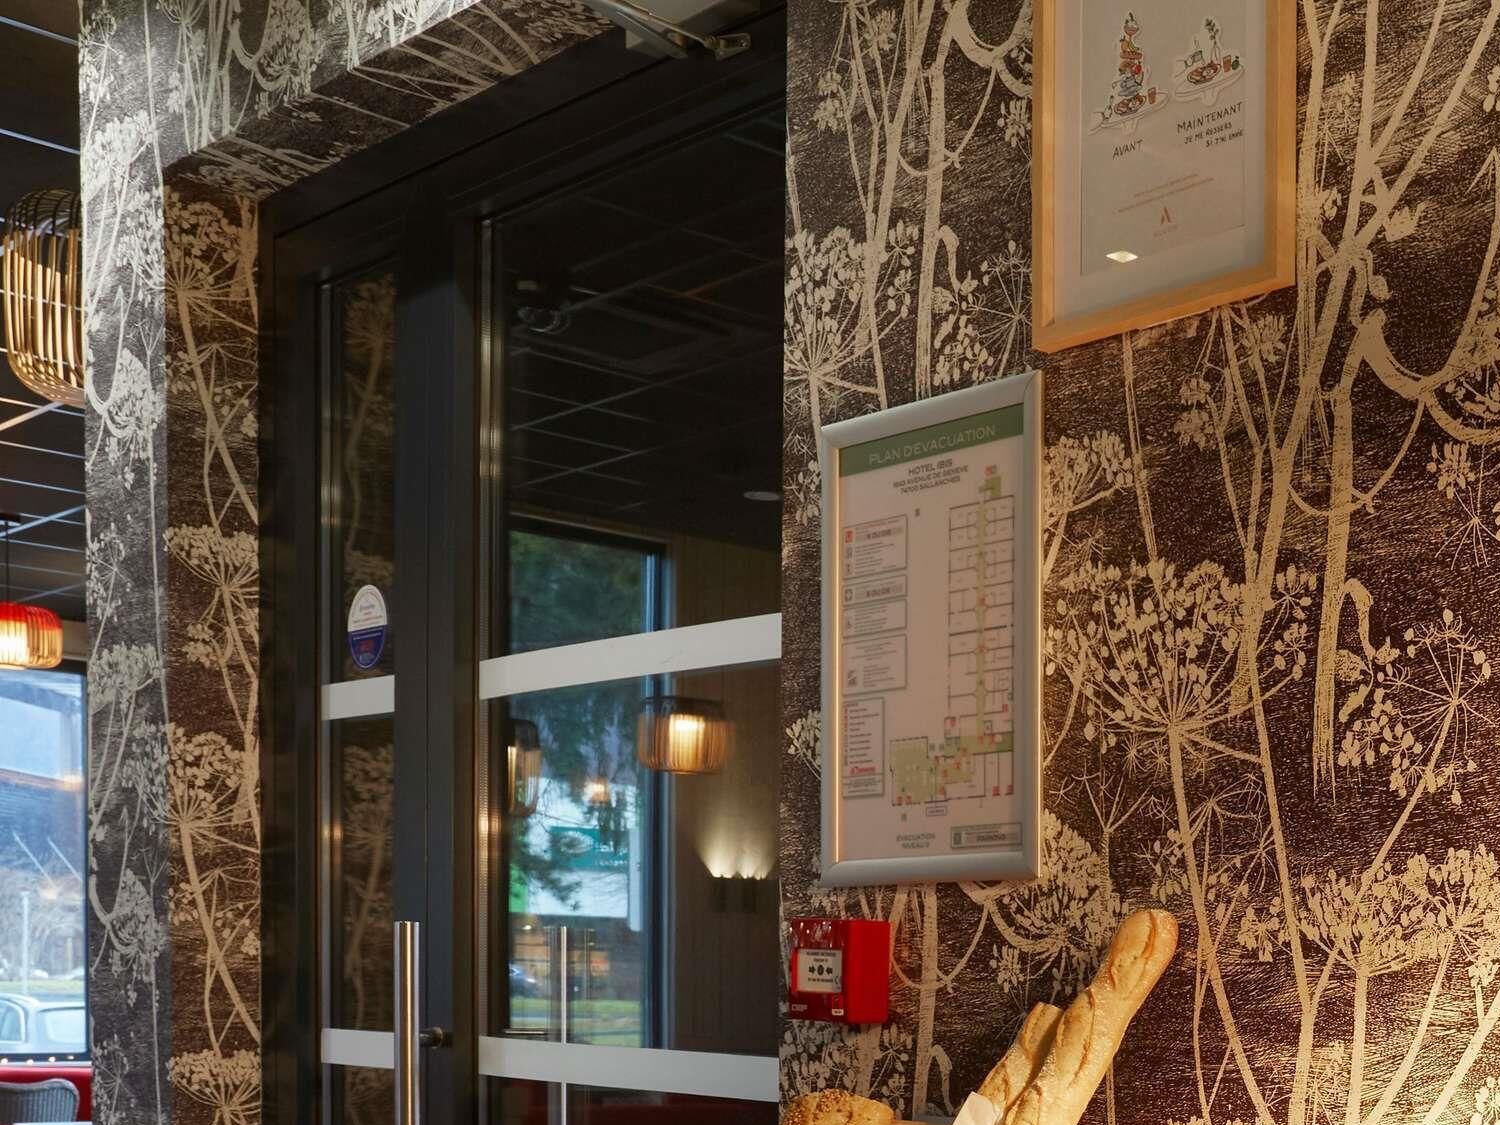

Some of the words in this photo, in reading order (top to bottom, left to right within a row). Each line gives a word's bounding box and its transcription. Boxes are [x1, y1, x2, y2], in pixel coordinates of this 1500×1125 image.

[1176, 100, 1243, 133] MAINTENANT
[1112, 138, 1144, 160] AVANT
[868, 445, 901, 465] PLAN
